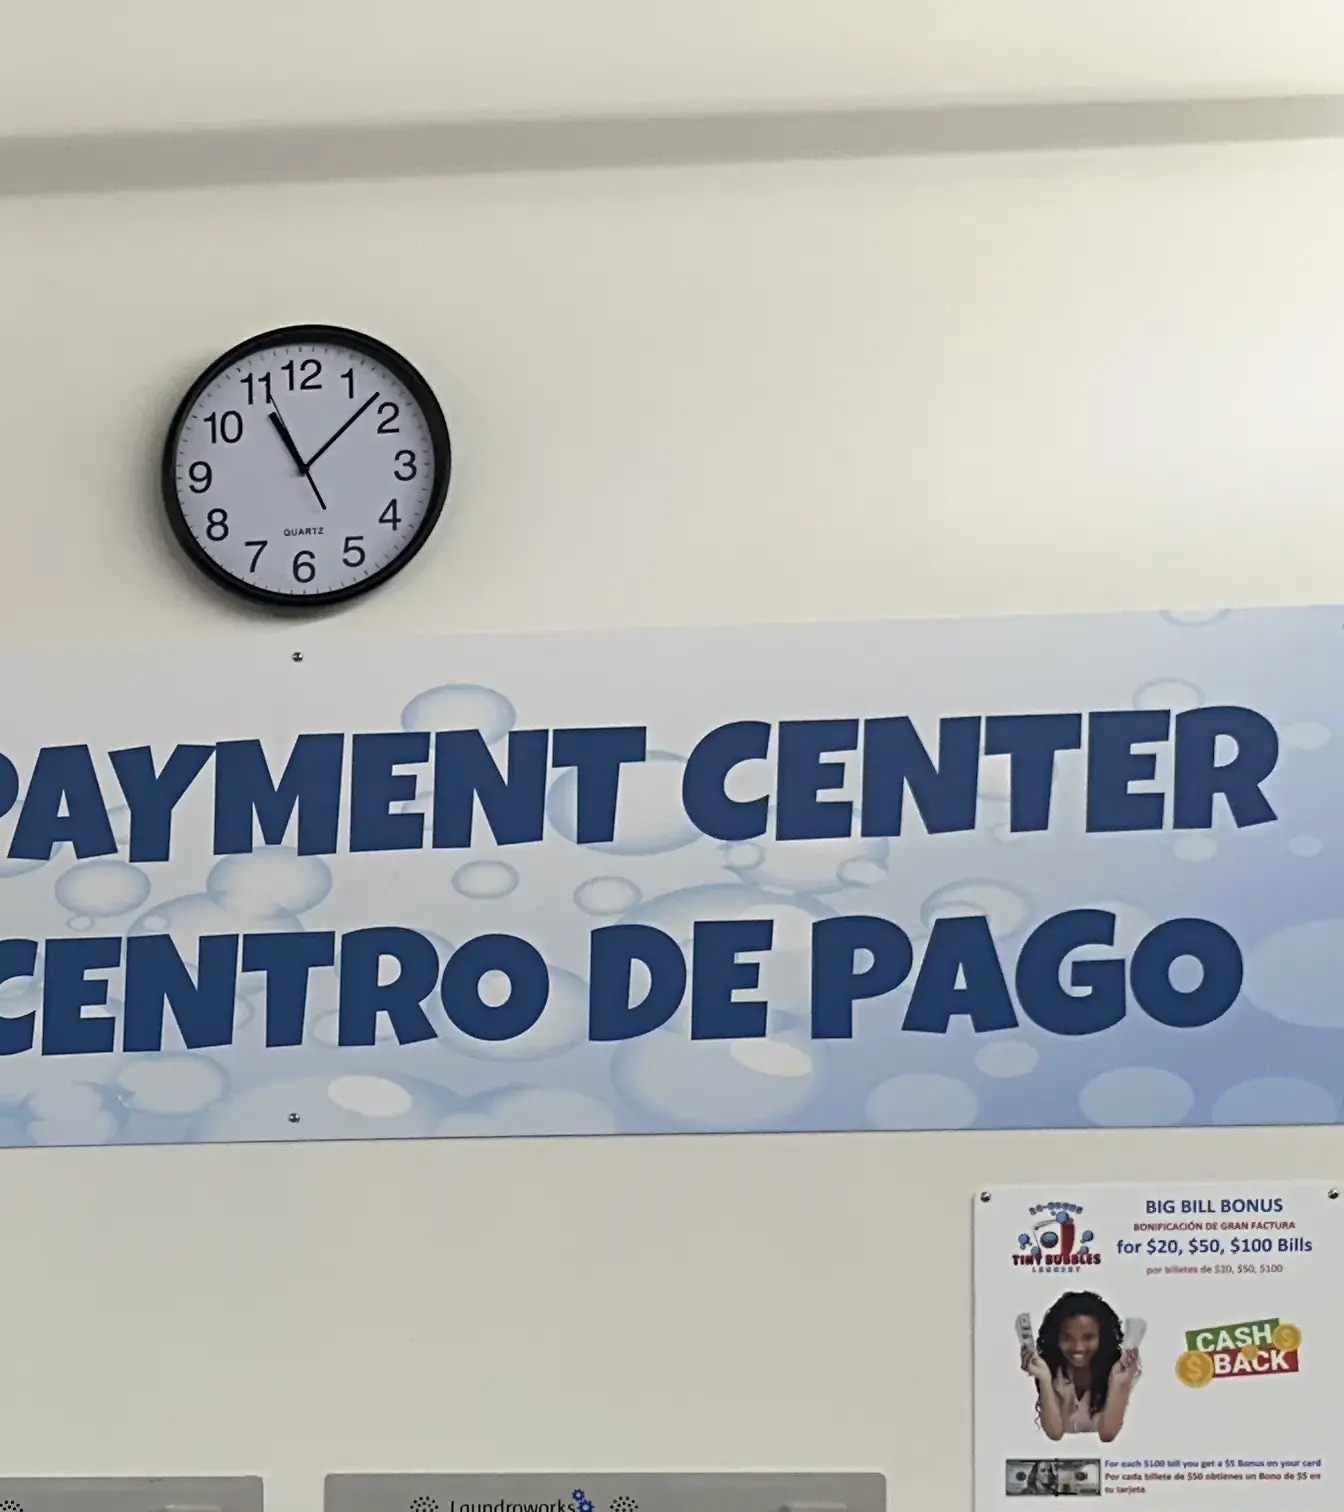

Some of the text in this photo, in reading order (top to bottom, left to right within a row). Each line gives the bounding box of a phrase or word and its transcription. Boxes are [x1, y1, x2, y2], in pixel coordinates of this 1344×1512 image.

[240, 371, 272, 405] 11
[280, 359, 323, 391] 12
[340, 368, 355, 399] 1
[204, 410, 243, 444] 10
[376, 402, 400, 434] 2
[188, 460, 212, 493] 9
[393, 449, 418, 482] 3
[206, 508, 229, 542] 8
[379, 499, 402, 531] 4
[283, 527, 324, 537] QUARTZ
[244, 540, 268, 573] 7
[292, 550, 316, 583] 6
[342, 535, 366, 567] 5
[683, 706, 1280, 841] CENTER
[587, 920, 773, 1042] DE
[810, 907, 1245, 1041] PAGO
[1146, 1198, 1283, 1213] BIG BILL BONUS
[1205, 1221, 1218, 1230] DE
[1220, 1221, 1249, 1230] GRAN
[1250, 1221, 1296, 1229] FACTURA
[1012, 1253, 1102, 1266] TINY BUBBLES
[1116, 1237, 1312, 1255] for $20, $50, $100 Bills
[1145, 1263, 1283, 1275] por billetes de $20, $50, $100
[1195, 1323, 1273, 1352] CASH
[1213, 1349, 1290, 1374] BACK
